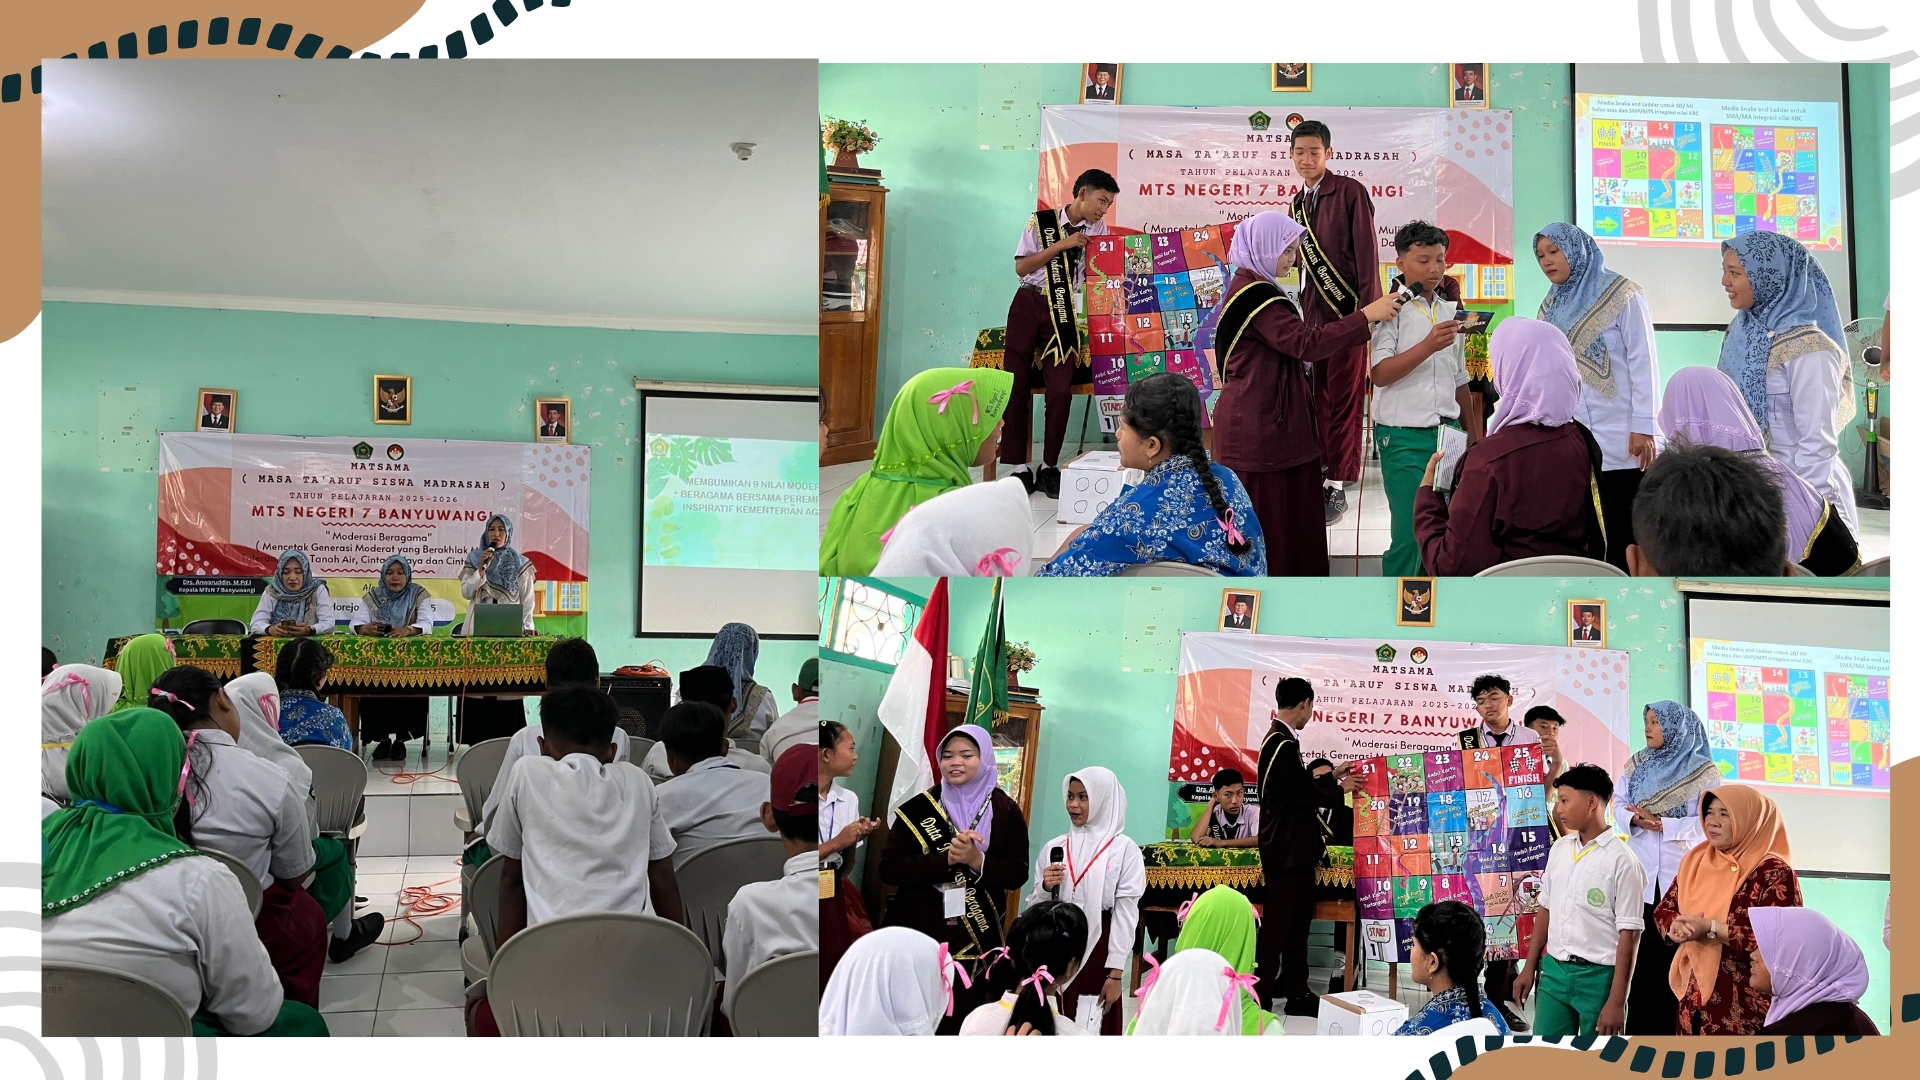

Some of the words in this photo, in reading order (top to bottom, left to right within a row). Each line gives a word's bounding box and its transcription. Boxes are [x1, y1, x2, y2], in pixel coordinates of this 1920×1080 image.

[1246, 134, 1291, 143] MATSA
[1146, 149, 1183, 158] MASA
[1194, 150, 1259, 159] TA'ARUF
[1688, 152, 1698, 160] 12
[1180, 168, 1216, 176] TAHUN
[1139, 183, 1176, 196] MTS
[1184, 183, 1250, 196] NEGERI
[1259, 184, 1269, 196] 7
[1694, 181, 1700, 189] 5
[1623, 209, 1630, 217] 2
[1665, 211, 1671, 219] 3
[1099, 241, 1114, 252] 21
[1134, 237, 1143, 248] 22
[1157, 236, 1170, 247] 23
[1193, 229, 1209, 242] 24
[1050, 256, 1065, 284] oderasi
[1303, 238, 1321, 266] oderasi
[1316, 265, 1345, 301] Beragama
[1106, 279, 1120, 289] 20
[1200, 269, 1215, 280] 17
[1053, 286, 1068, 323] Beragama
[1136, 317, 1151, 328] 12
[1180, 313, 1193, 324] 13
[1100, 332, 1113, 343] 11
[1111, 357, 1125, 369] 10
[1153, 355, 1161, 366] 9
[1174, 353, 1182, 365] 8
[1104, 417, 1111, 429] 1
[351, 462, 410, 472] MATSAMA
[258, 474, 293, 484] MASA
[302, 475, 362, 485] TA'ARUF
[372, 478, 414, 487] SISWA
[423, 479, 490, 489] MADRASAH
[686, 477, 751, 488] MEMBUMIKAN
[753, 480, 759, 488] 9
[760, 481, 785, 489] NILAI
[289, 492, 323, 500] TAHUN
[331, 493, 391, 501] PELAJARAN
[399, 495, 458, 503] 2025-2026
[680, 490, 734, 500] BERAGAMA
[736, 492, 781, 502] BERSAMA
[251, 505, 286, 517] MTS
[293, 506, 354, 518] NEGERI
[362, 507, 371, 519] 7
[682, 503, 734, 513] INSPIRATIF
[736, 505, 803, 515] KEMENTERIAN
[379, 532, 432, 543] Beragama"
[262, 543, 309, 551] Mencetak
[311, 543, 353, 552] Generasi
[355, 544, 395, 553] Moderat
[397, 546, 420, 556] yang
[422, 545, 468, 554] Berakhlak
[310, 554, 339, 564] Tanah
[341, 555, 358, 566] Air,
[425, 557, 444, 565] dan
[1372, 665, 1434, 676] MATSAMA
[1839, 662, 1865, 670] SMA/MA
[1772, 669, 1783, 677] 14
[1798, 671, 1808, 679] 13
[1323, 679, 1384, 689] TA'ARUF
[1394, 682, 1438, 692] SISWA
[1352, 697, 1414, 706] PELAJARAN
[1422, 700, 1476, 710] 2025-202
[1803, 699, 1813, 707] 12
[1312, 710, 1375, 724] NEGERI
[1383, 713, 1393, 725] 7
[1809, 728, 1816, 736] 5
[1362, 763, 1376, 774] 21
[1397, 757, 1412, 767] 22
[1435, 753, 1450, 764] 23
[1473, 750, 1490, 762] 24
[1513, 747, 1530, 758] 25
[1738, 752, 1746, 760] 2
[1780, 756, 1787, 764] 3
[1508, 773, 1540, 784] FINISH
[1370, 801, 1385, 810] 20
[1407, 796, 1420, 807] 19
[1439, 794, 1453, 804] 18
[1476, 791, 1491, 802] 17
[1517, 787, 1532, 799] 16
[1403, 838, 1417, 850] 12
[1448, 835, 1463, 846] 13
[1491, 843, 1506, 854] 14
[1521, 831, 1537, 843] 15
[1366, 854, 1379, 865] 11
[1513, 848, 1528, 856] Ambil
[1528, 844, 1545, 853] Kartu
[1517, 852, 1545, 864] Tantangan
[920, 817, 943, 841] Duta
[965, 887, 989, 933] Beragama
[1376, 880, 1391, 891] 10
[1419, 878, 1427, 890] 9
[1441, 878, 1449, 889] 8
[1499, 875, 1507, 887] 7
[1368, 927, 1387, 938] START
[1485, 923, 1494, 935] 4
[1370, 943, 1377, 956] 1
